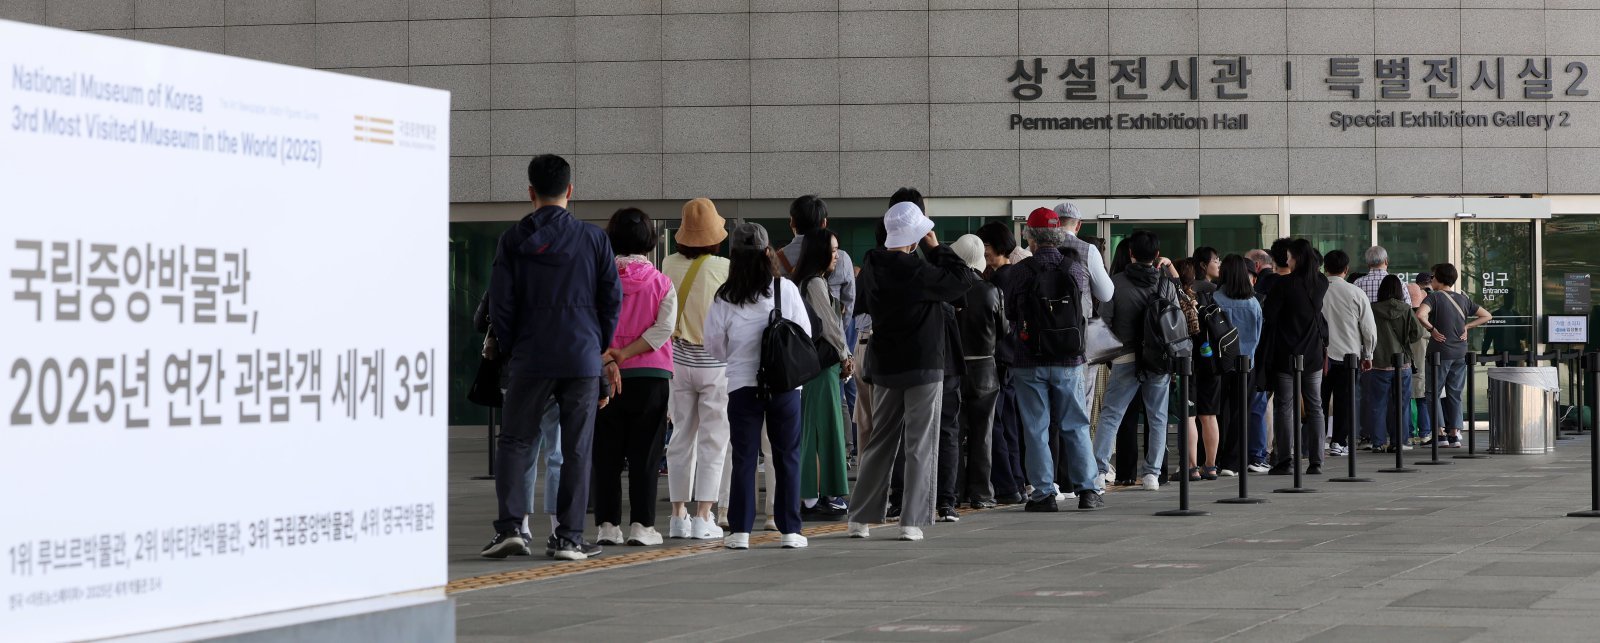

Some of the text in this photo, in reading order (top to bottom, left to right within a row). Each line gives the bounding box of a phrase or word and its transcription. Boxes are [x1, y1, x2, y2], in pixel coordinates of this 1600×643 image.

[12, 64, 77, 97] National
[80, 73, 144, 105] Museum
[147, 83, 162, 108] of
[165, 84, 203, 113] Korea
[1007, 56, 1589, 100] 상설전시관 특별전시실2
[12, 105, 322, 169] 3rd Most Visited Museum in the World (2025)
[1010, 112, 1248, 130] Permanent Exhibition Hall
[1330, 110, 1571, 131] Special Exhibition Gallery 2
[10, 238, 259, 335] 국립중앙박물관,
[1482, 271, 1509, 287] 입구
[10, 348, 435, 429] 2025년 연간 관람객 세계 3위
[9, 501, 435, 576] 1위 루브르박물관, 2위 바티칸박물관, 3위 국립중앙박물관, 4위 영국박물관
